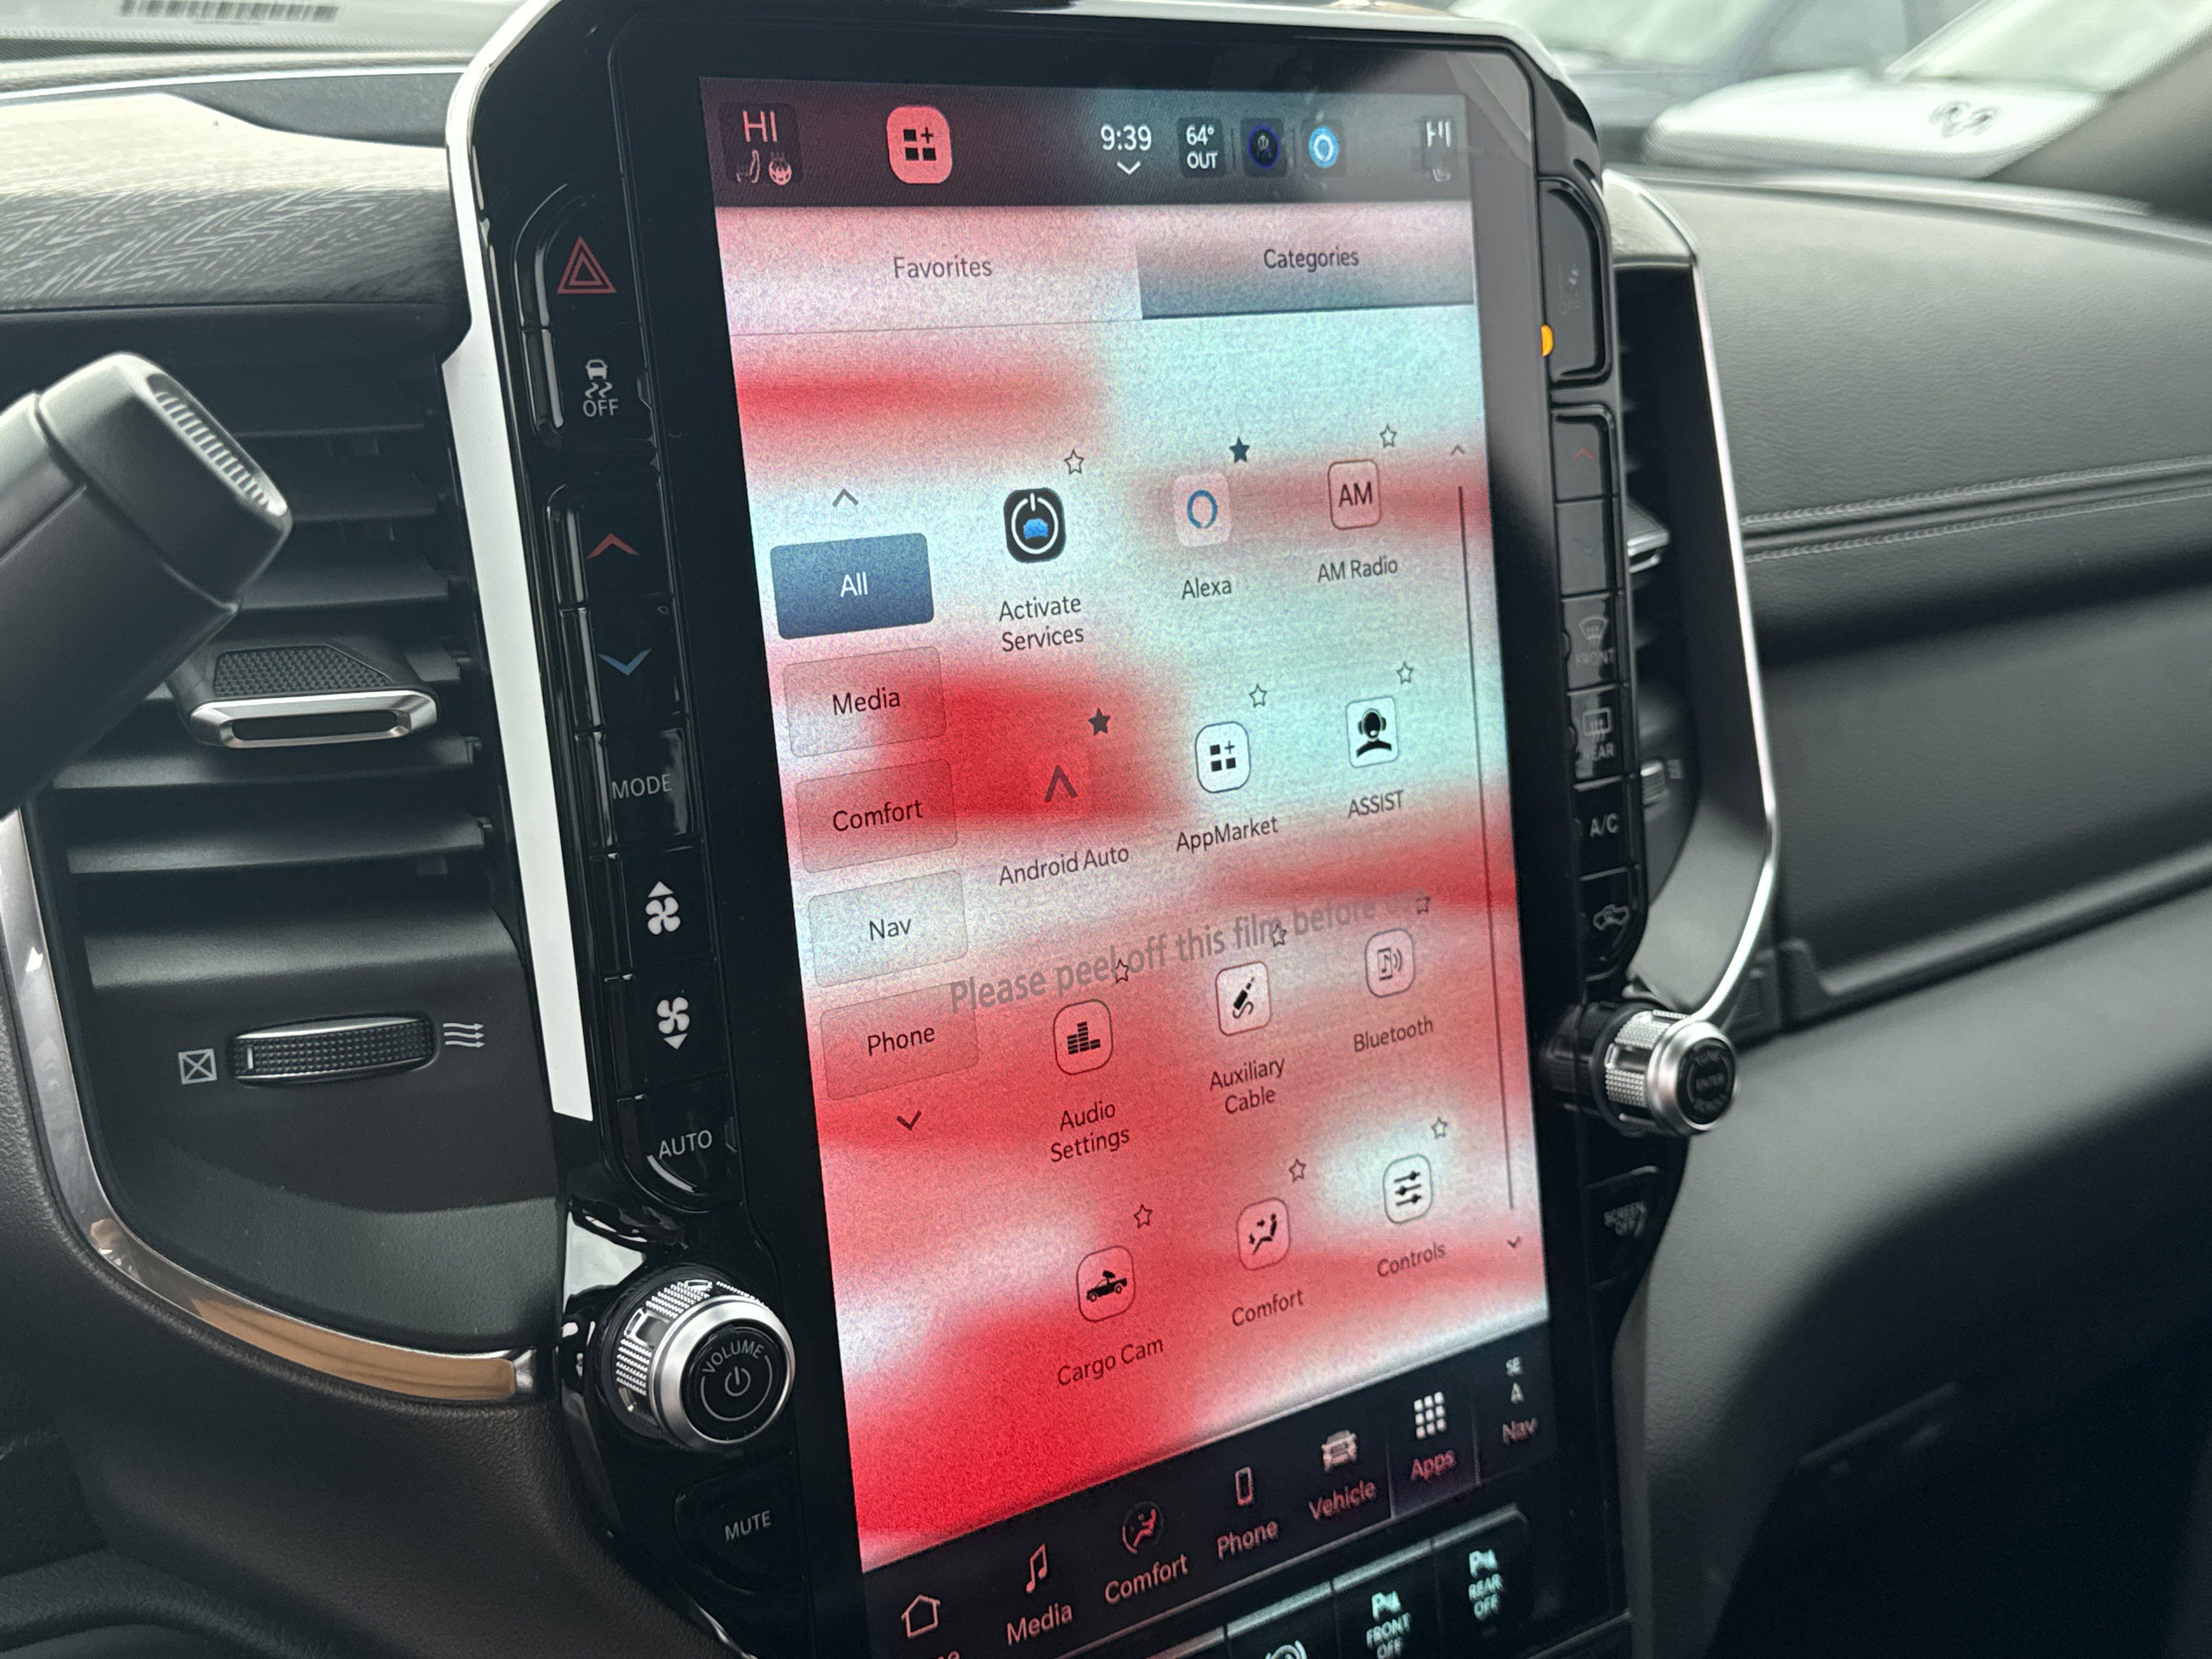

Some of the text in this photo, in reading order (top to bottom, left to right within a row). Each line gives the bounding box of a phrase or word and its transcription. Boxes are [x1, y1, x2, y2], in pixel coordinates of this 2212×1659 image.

[742, 110, 778, 143] HI
[1100, 124, 1153, 151] 9:39
[1185, 124, 1215, 146] 64°
[1426, 119, 1452, 148] HI
[1187, 151, 1218, 170] OUT
[893, 255, 992, 279] Favorites
[1263, 245, 1360, 273] Categories
[582, 398, 619, 417] OFF
[1338, 481, 1373, 508] AM
[840, 571, 869, 598] All
[1317, 555, 1398, 583] AM Radio
[1181, 577, 1232, 600] Alexa
[998, 594, 1082, 622] Activate
[1002, 625, 1085, 652] Services
[832, 687, 901, 715] Media
[611, 772, 674, 800] MODE
[832, 799, 923, 832] Comfort
[1347, 789, 1404, 819] ASSIST
[1176, 815, 1279, 854] AppMarket
[1590, 812, 1618, 838] A/C
[998, 844, 1130, 887] Android Auto
[868, 918, 912, 942] Nav
[950, 970, 1045, 1014] Please
[1053, 944, 1117, 997] peel
[1127, 933, 1170, 973] off
[1176, 922, 1225, 963] this
[1233, 912, 1284, 950] film
[1293, 898, 1375, 936] before
[867, 1025, 935, 1056] Phone
[1353, 1016, 1434, 1053] Bluetooth
[1210, 1058, 1285, 1092] Auxiliary
[1059, 1100, 1116, 1132] Audio
[1224, 1086, 1276, 1115] Cable
[658, 1128, 714, 1159] AUTO
[1051, 1127, 1131, 1163] Settings
[1377, 1241, 1446, 1278] Controls
[1231, 1288, 1305, 1328] Comfort
[702, 1339, 765, 1375] VOLUME
[1057, 1337, 1165, 1387] Cargo Cam
[1502, 1417, 1538, 1446] Nav
[1409, 1449, 1457, 1481] Apps
[1307, 1480, 1378, 1522] Vehicle
[725, 1510, 772, 1542] MUTE
[1217, 1520, 1280, 1560] Phone
[1104, 1552, 1189, 1605] Comfort
[1474, 1594, 1500, 1620] OFF
[1006, 1602, 1073, 1646] Media
[1366, 1612, 1411, 1649] FRONT
